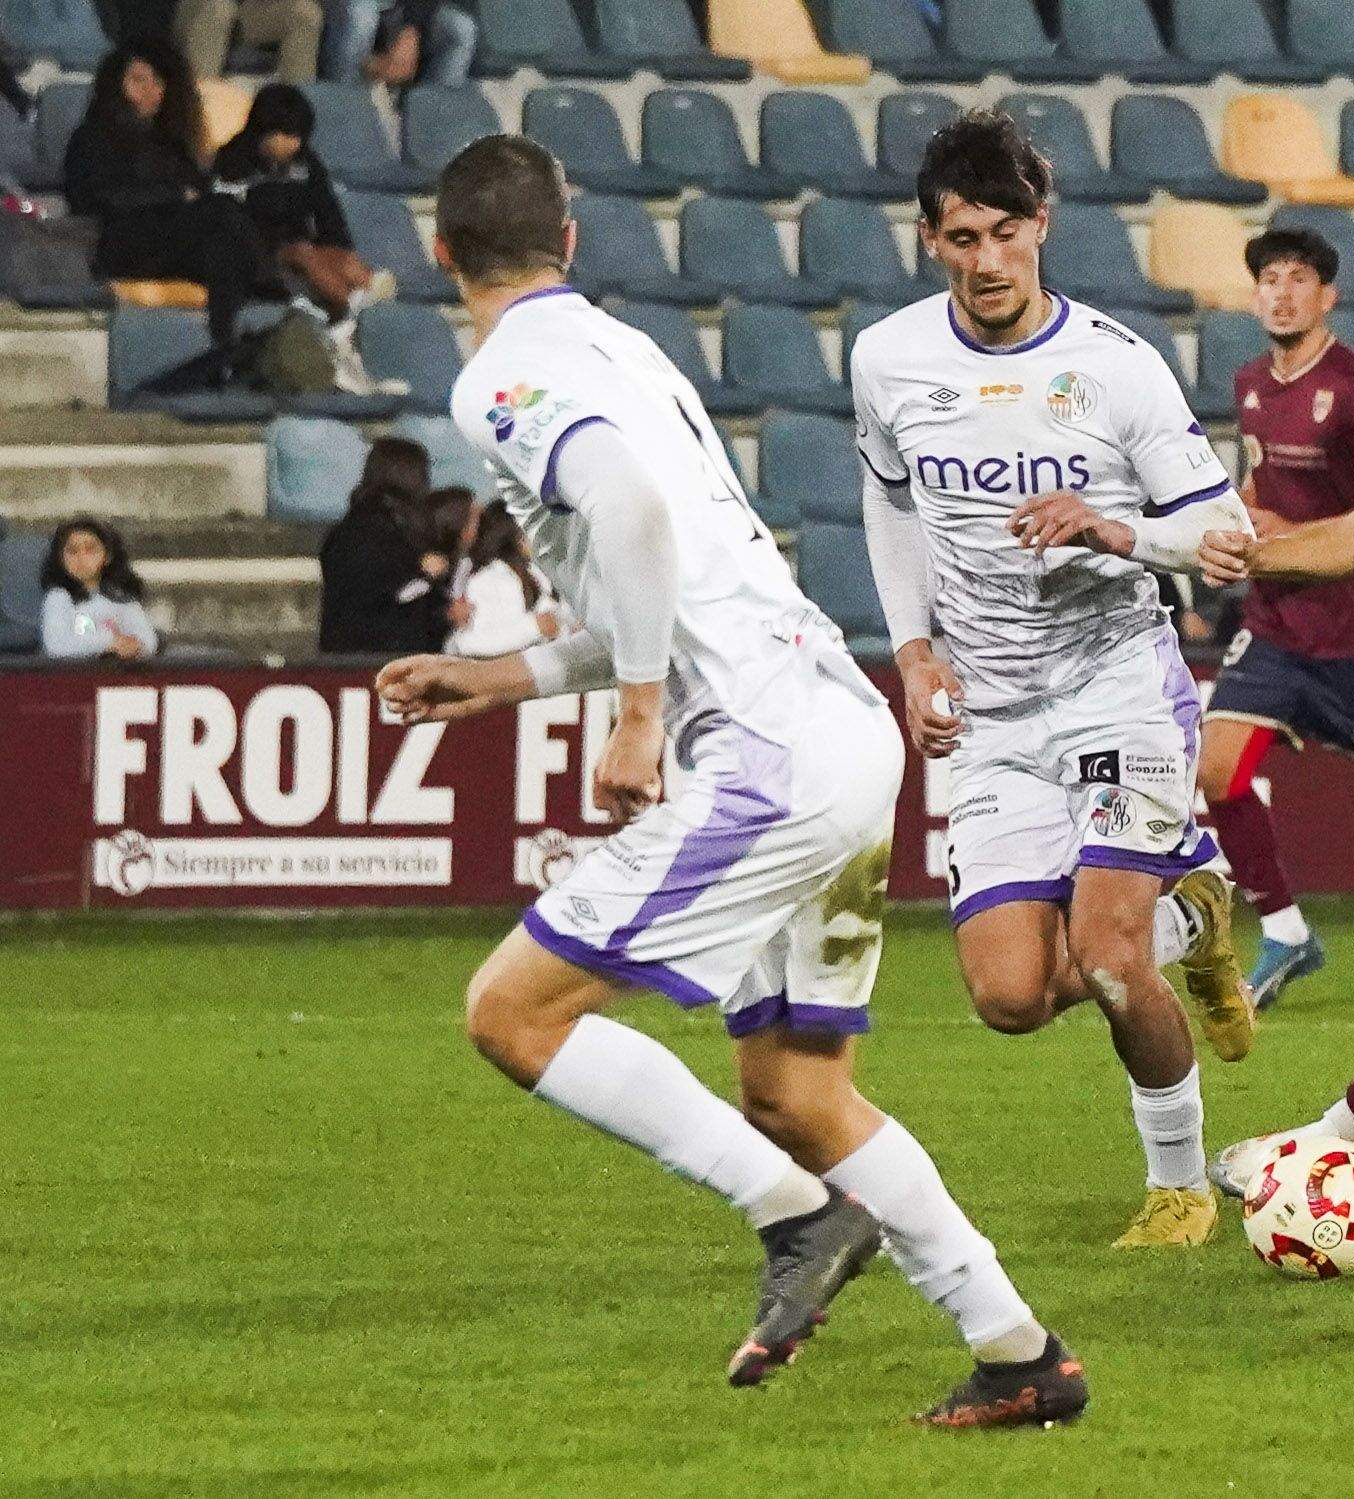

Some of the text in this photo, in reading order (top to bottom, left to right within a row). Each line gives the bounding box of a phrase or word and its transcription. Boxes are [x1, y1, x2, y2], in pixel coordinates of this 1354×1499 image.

[917, 450, 1091, 495] meins
[94, 684, 456, 826] FROIZ
[1126, 763, 1177, 775] Gonzalo
[164, 849, 273, 884] Siempre
